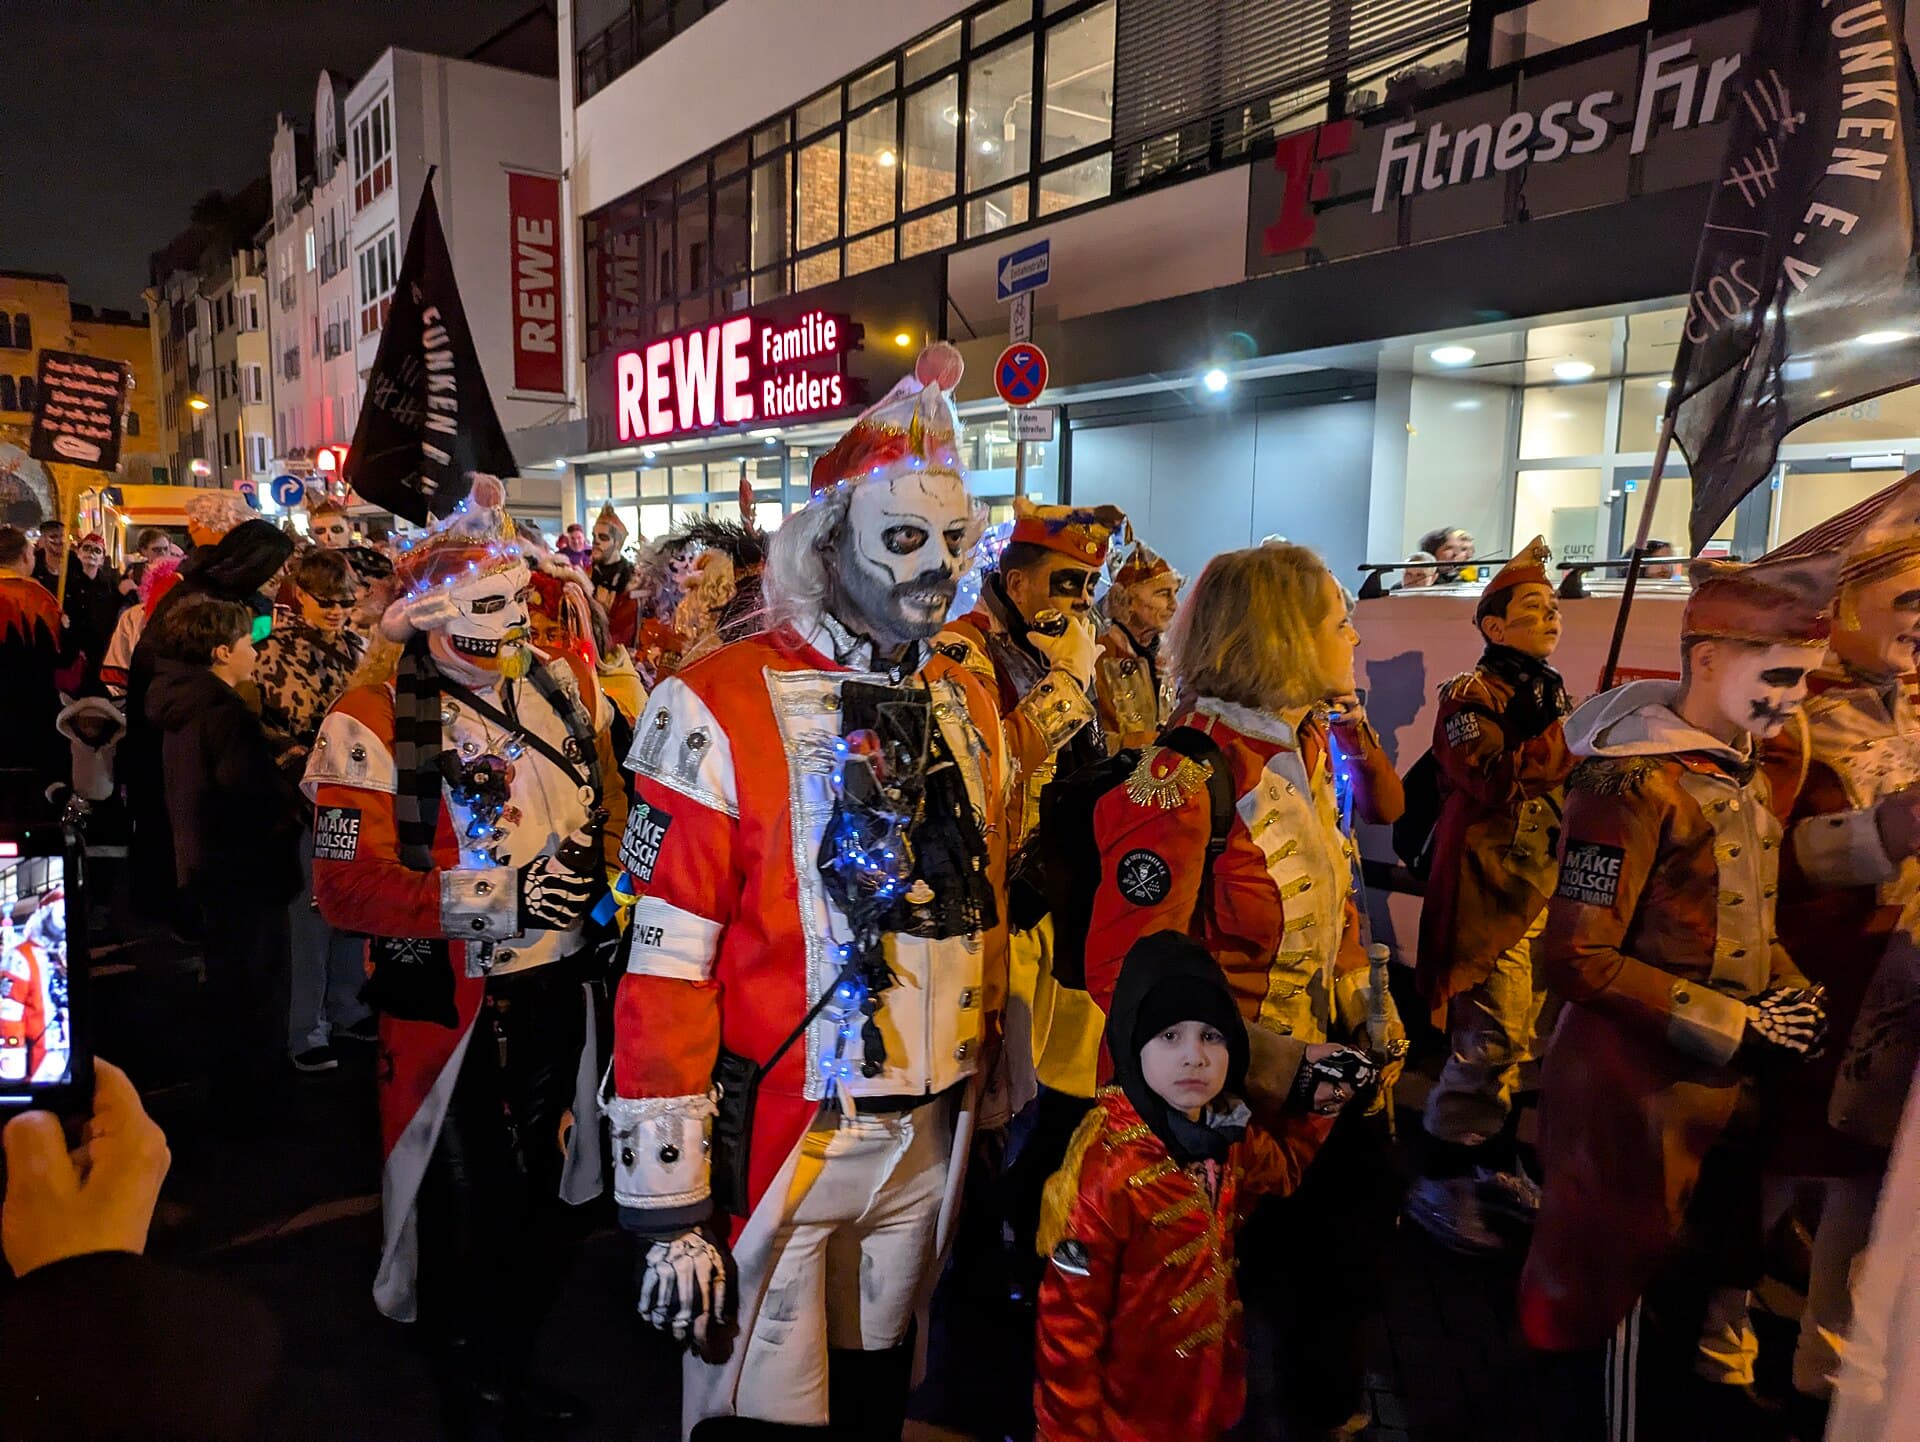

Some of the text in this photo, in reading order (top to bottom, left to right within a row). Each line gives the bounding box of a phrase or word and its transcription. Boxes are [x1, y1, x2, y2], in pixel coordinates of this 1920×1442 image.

[1821, 0, 1897, 180] UNKEN
[1372, 90, 1615, 213] Fitness
[518, 216, 556, 353] REWE
[617, 312, 837, 441] REWE Familie
[763, 370, 842, 417] Ridders
[315, 832, 357, 849] KÖLSCH
[316, 815, 360, 834] MAKE
[627, 806, 666, 848] MAKE
[330, 848, 355, 861] WAR!
[627, 856, 653, 881] WAR!
[1565, 851, 1621, 877] MAKE
